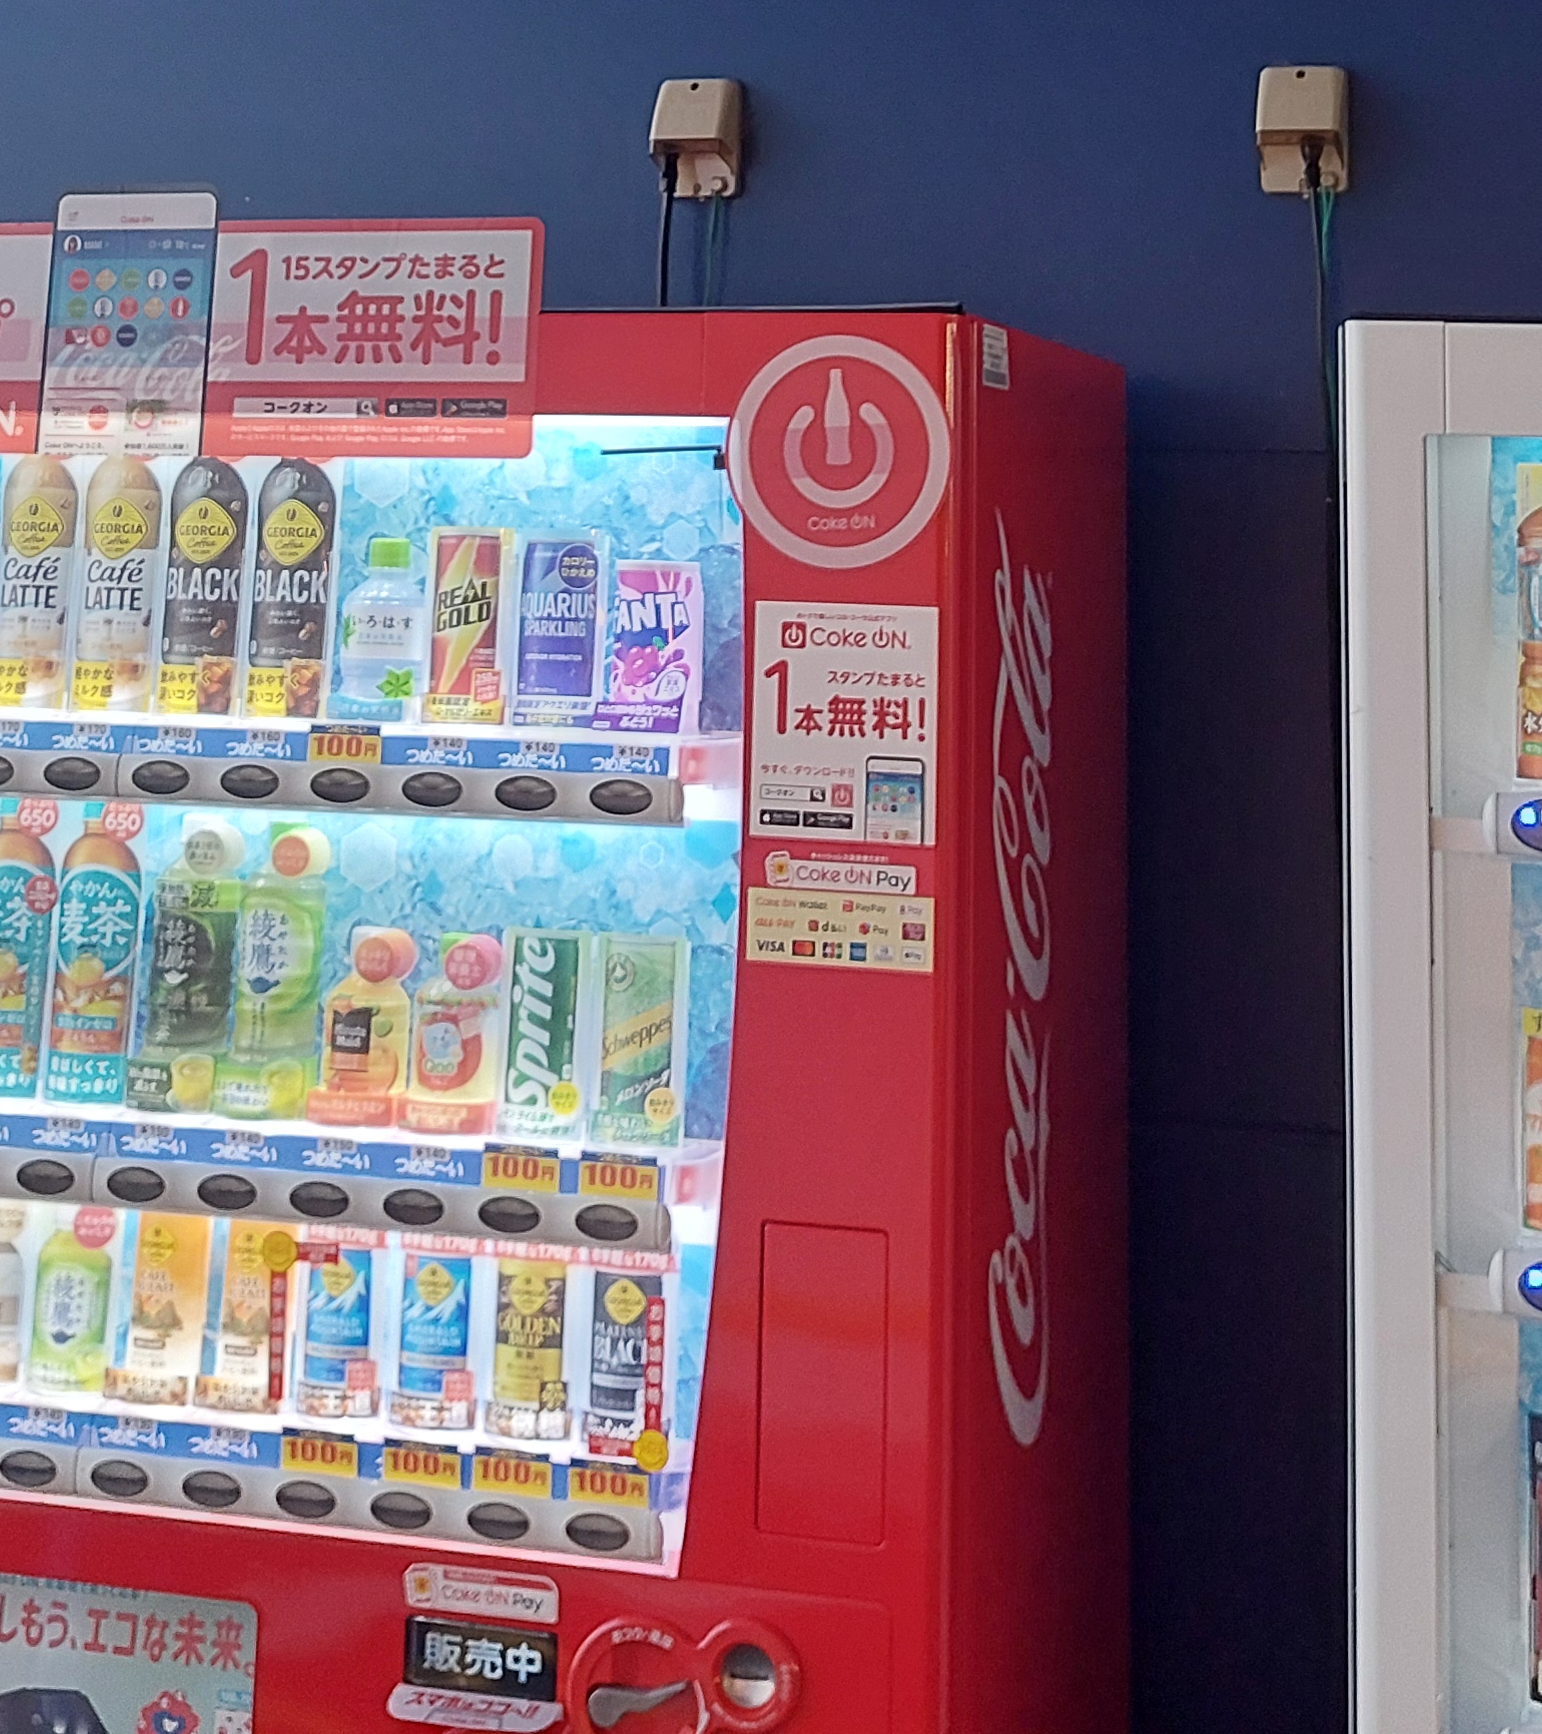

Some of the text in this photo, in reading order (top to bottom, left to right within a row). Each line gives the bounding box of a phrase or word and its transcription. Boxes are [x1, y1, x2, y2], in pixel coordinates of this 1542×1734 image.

[282, 253, 506, 281] 15スタンプたまると
[263, 400, 329, 414] コークオン
[10, 521, 61, 533] GEORGIA
[93, 523, 144, 535] GEORGIA
[179, 525, 230, 537] GEORGIA
[266, 526, 317, 538] GEORGIA
[807, 512, 876, 532] Coke ON
[3, 557, 61, 583] Café
[87, 558, 144, 583] Café
[562, 556, 595, 567] カロリー
[0, 584, 57, 609] LATTE
[167, 567, 238, 601] BLACK
[254, 570, 327, 603] BLACK
[438, 578, 491, 610] REAL
[84, 586, 143, 611] LATTE
[435, 602, 491, 633] GOLD
[524, 618, 586, 638] SPARKLING
[811, 627, 867, 648] Coke
[827, 670, 927, 688] スタンプたまると
[163, 727, 193, 739] ¥160
[431, 738, 464, 749] ¥140
[313, 734, 378, 759] 100円
[524, 741, 556, 753] ¥140
[617, 746, 649, 758] ¥140
[19, 809, 56, 828] 650
[104, 812, 142, 831] 650
[796, 866, 912, 892] Coke ON Pay
[60, 898, 135, 947] 麦茶
[248, 908, 278, 975] 綾鷹
[756, 940, 785, 953] VISA
[990, 505, 1056, 1448] Coca-Cola
[508, 935, 556, 1109] Sprite
[602, 1017, 673, 1060] Schweppes
[615, 1067, 671, 1106] メロンソーダ
[488, 1156, 555, 1182] 100円
[584, 1164, 654, 1190] 100円
[498, 1315, 561, 1335] GOLDEN
[288, 1438, 354, 1464] 100円
[390, 1449, 456, 1477] 100円
[482, 1458, 548, 1485] 100円
[577, 1469, 645, 1497] 100円
[441, 1583, 546, 1614] Coke ON Pay
[421, 1631, 543, 1684] 販売中
